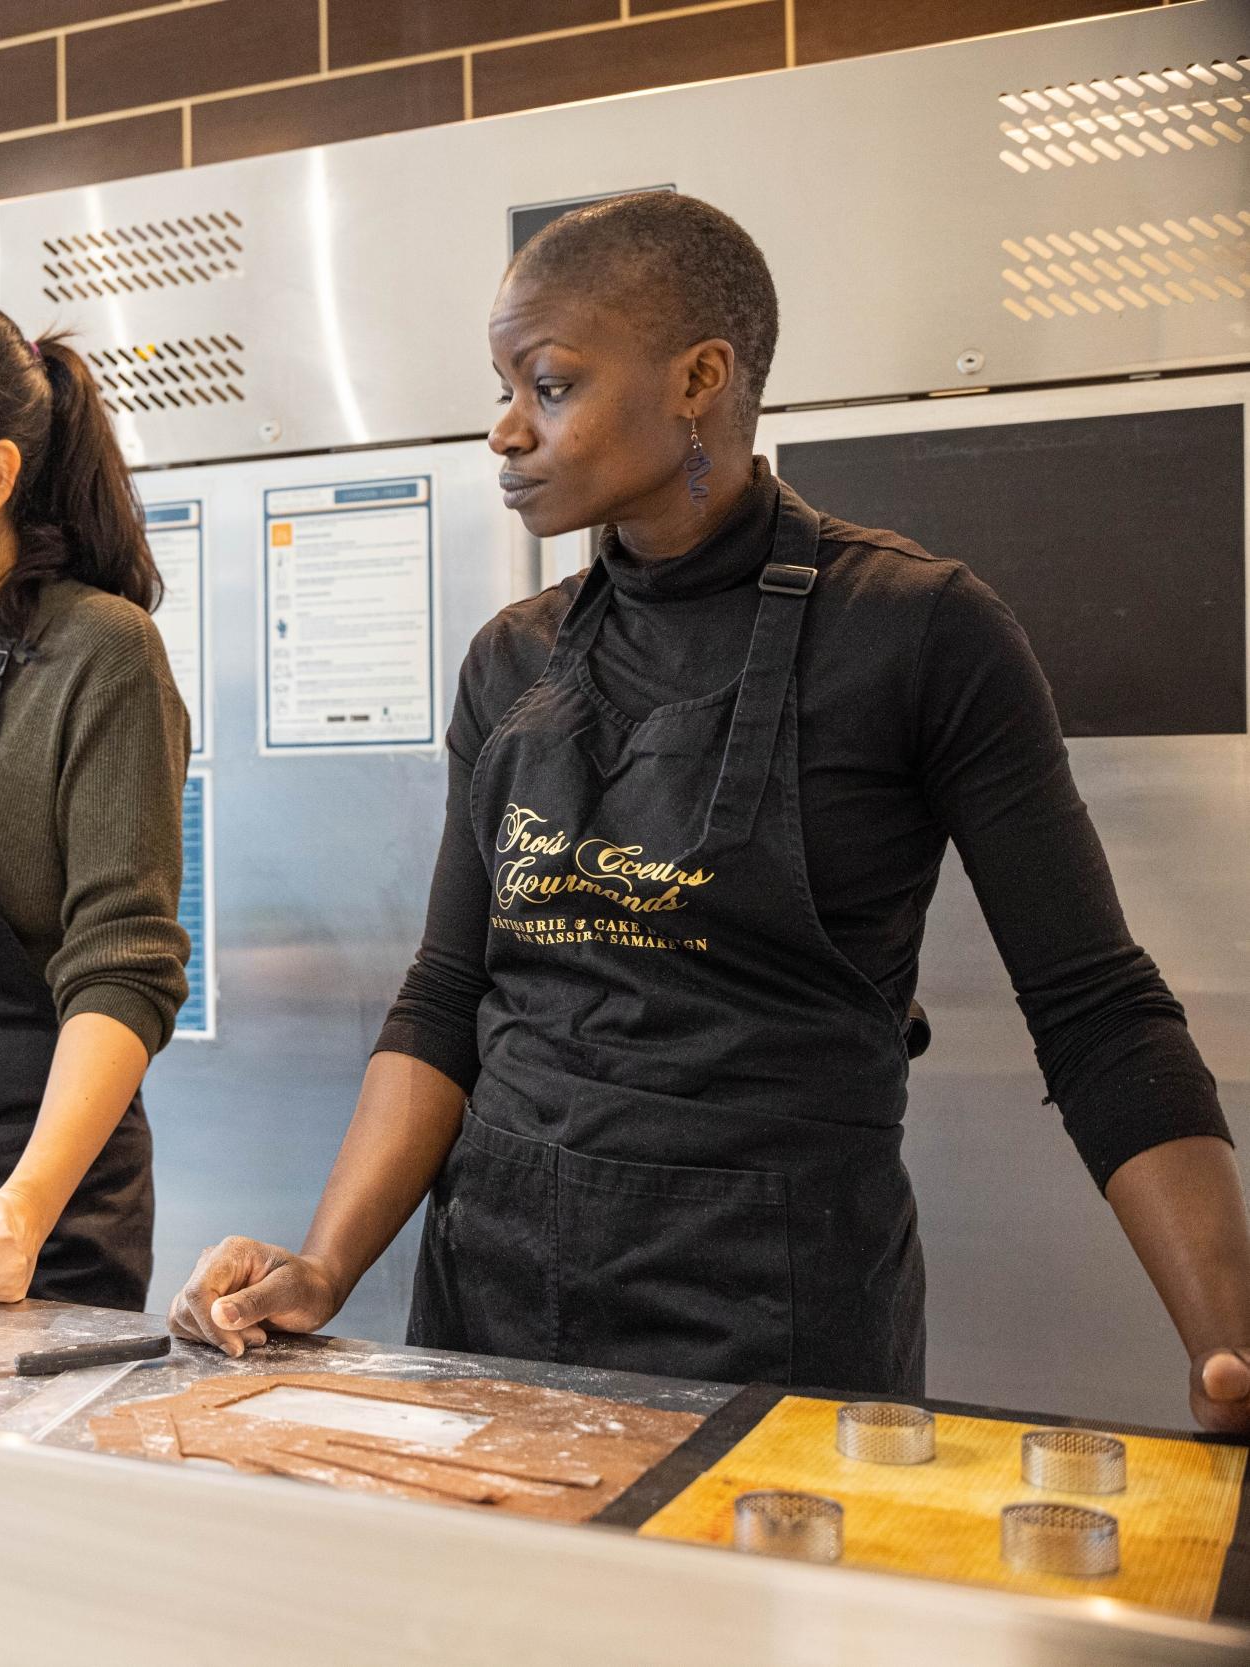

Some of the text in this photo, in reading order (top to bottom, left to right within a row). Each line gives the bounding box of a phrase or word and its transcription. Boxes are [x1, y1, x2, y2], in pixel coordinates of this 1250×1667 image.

[496, 803, 715, 893] Trois Coeurs
[496, 856, 688, 912] Gourmands
[491, 914, 566, 933] PÂTISSERIE
[574, 918, 586, 930] &
[594, 918, 640, 933] CAKE
[514, 931, 533, 943] PAR
[534, 930, 604, 944] NASSIRA
